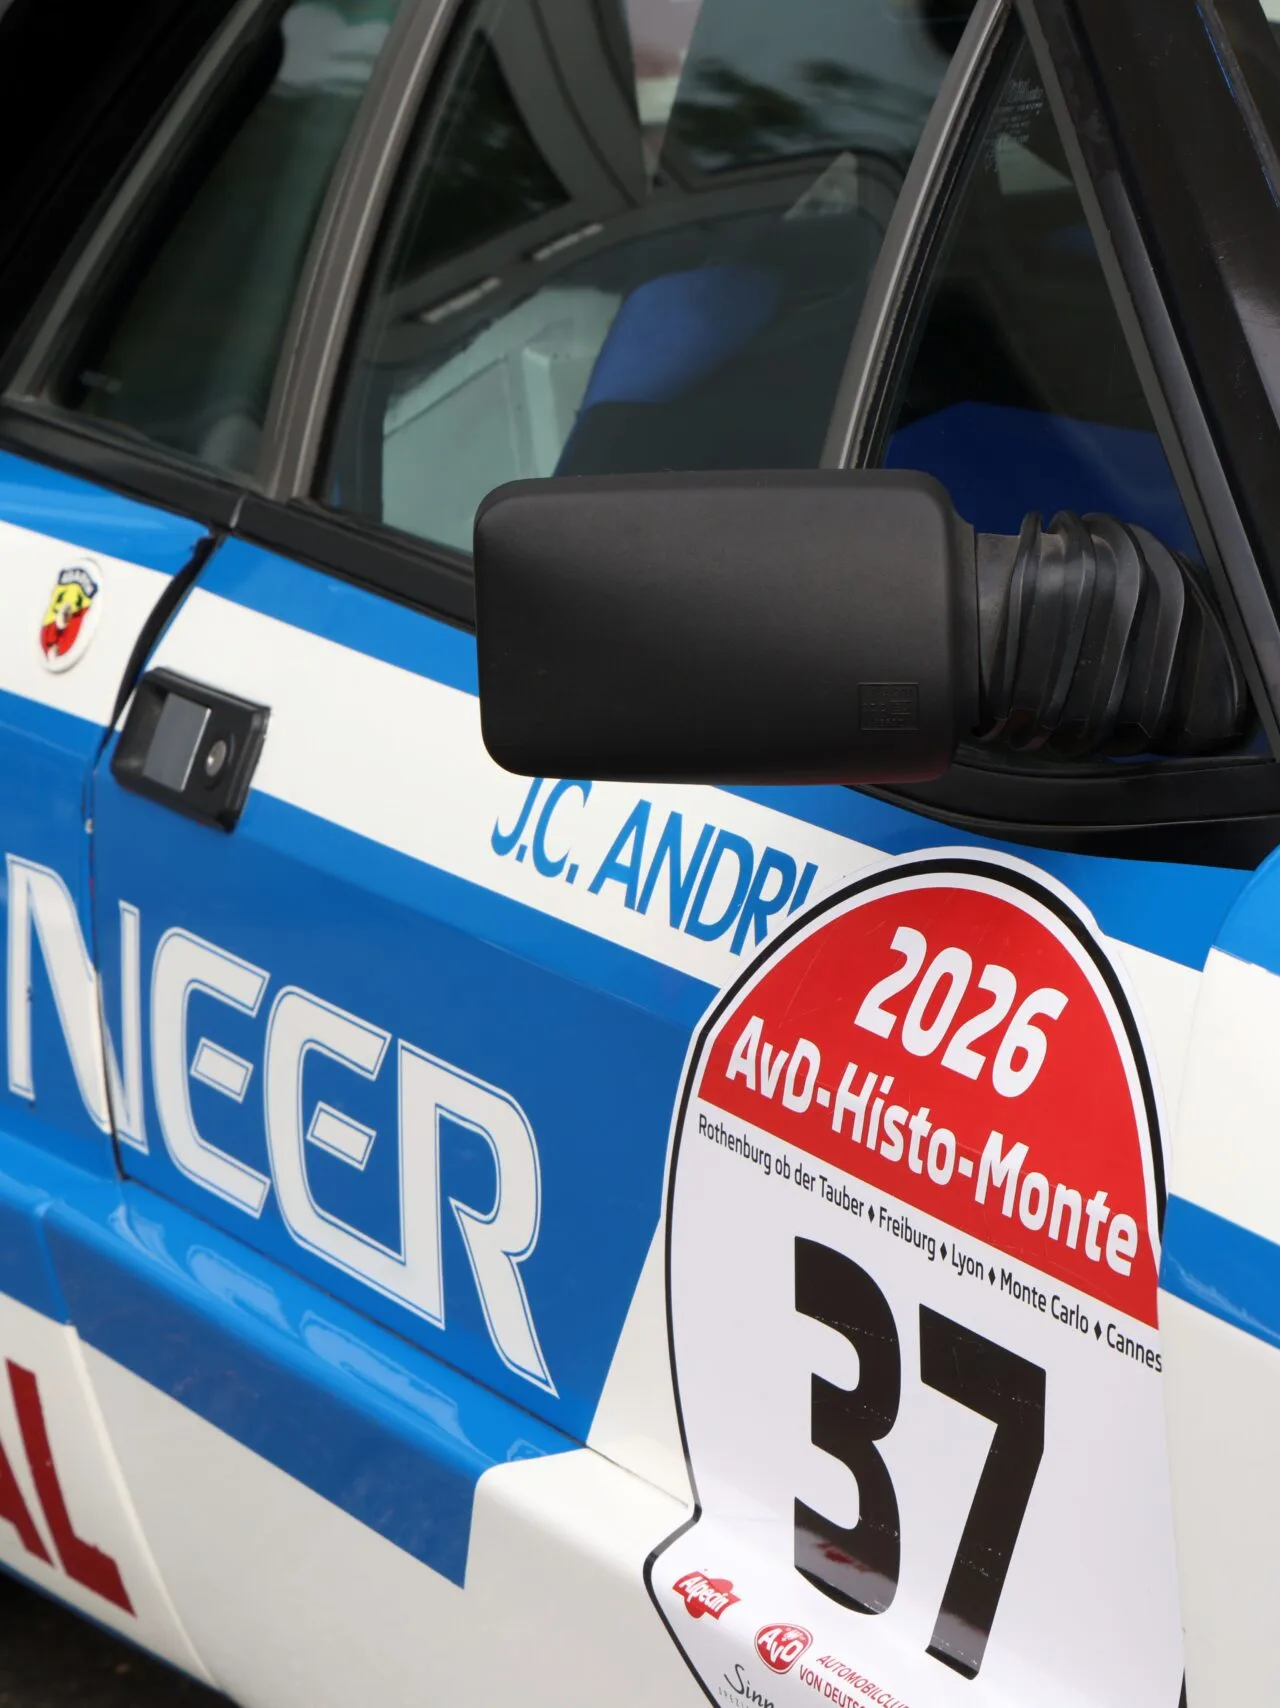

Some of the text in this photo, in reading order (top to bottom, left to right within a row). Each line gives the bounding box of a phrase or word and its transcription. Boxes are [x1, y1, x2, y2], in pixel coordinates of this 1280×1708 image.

[490, 777, 592, 885] J.C.
[6, 853, 560, 1399] NEER
[854, 926, 1069, 1098] 2026
[698, 1114, 1162, 1373] Rothenburg ob der Tauber Freiburg Lyon Monte Carlo Cannes
[725, 1015, 1139, 1277] AvD-Histo-Monte
[794, 1236, 1047, 1680] 37
[800, 1664, 867, 1708] VON DEUTS
